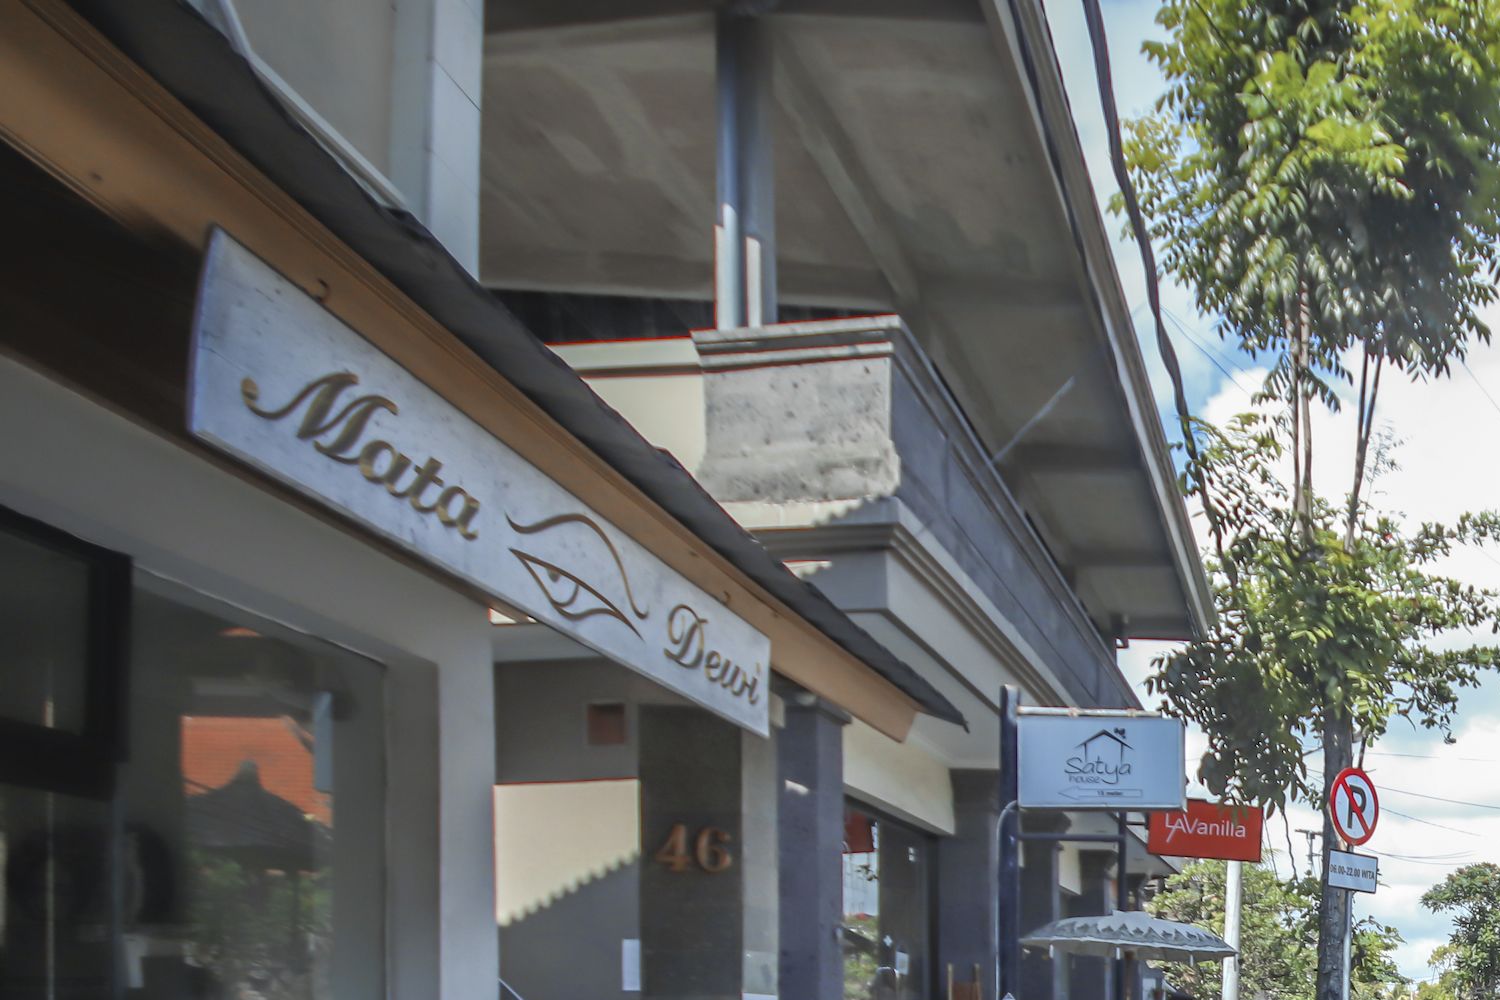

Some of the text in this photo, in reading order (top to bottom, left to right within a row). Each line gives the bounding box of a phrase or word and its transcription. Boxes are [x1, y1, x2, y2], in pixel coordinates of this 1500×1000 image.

[239, 371, 761, 706] Mata Dewi
[1064, 755, 1132, 785] Satya
[1068, 773, 1102, 784] house
[655, 823, 732, 873] 46
[1361, 869, 1375, 880] WITA
